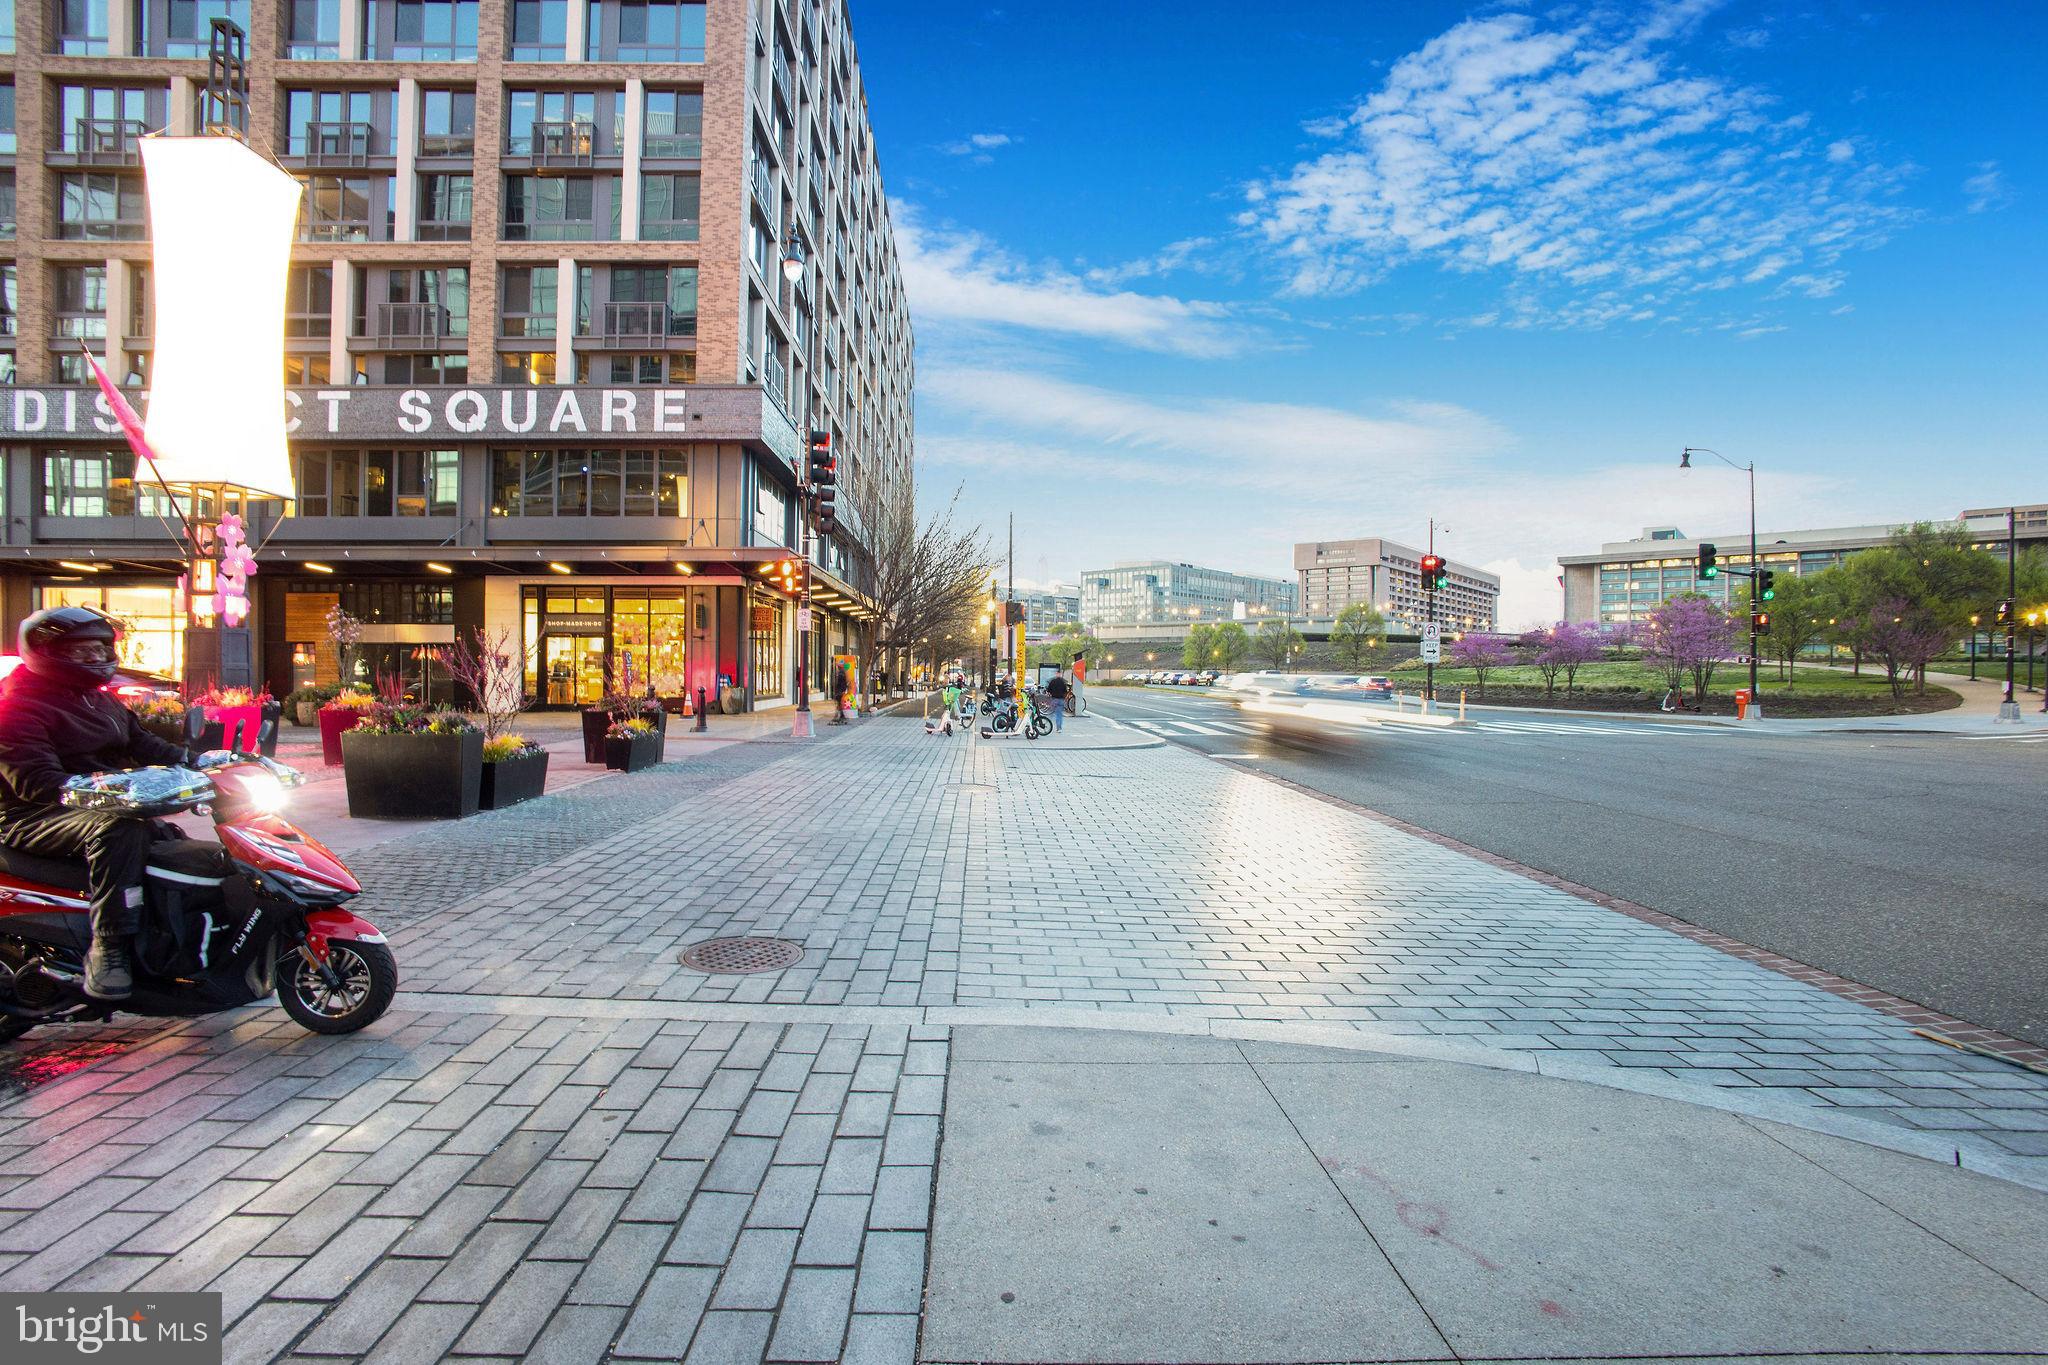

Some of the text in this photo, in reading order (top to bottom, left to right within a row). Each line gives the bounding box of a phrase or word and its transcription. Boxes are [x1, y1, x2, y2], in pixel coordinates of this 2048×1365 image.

[397, 389, 686, 433] SQUARE
[232, 907, 261, 954] FLY WING
